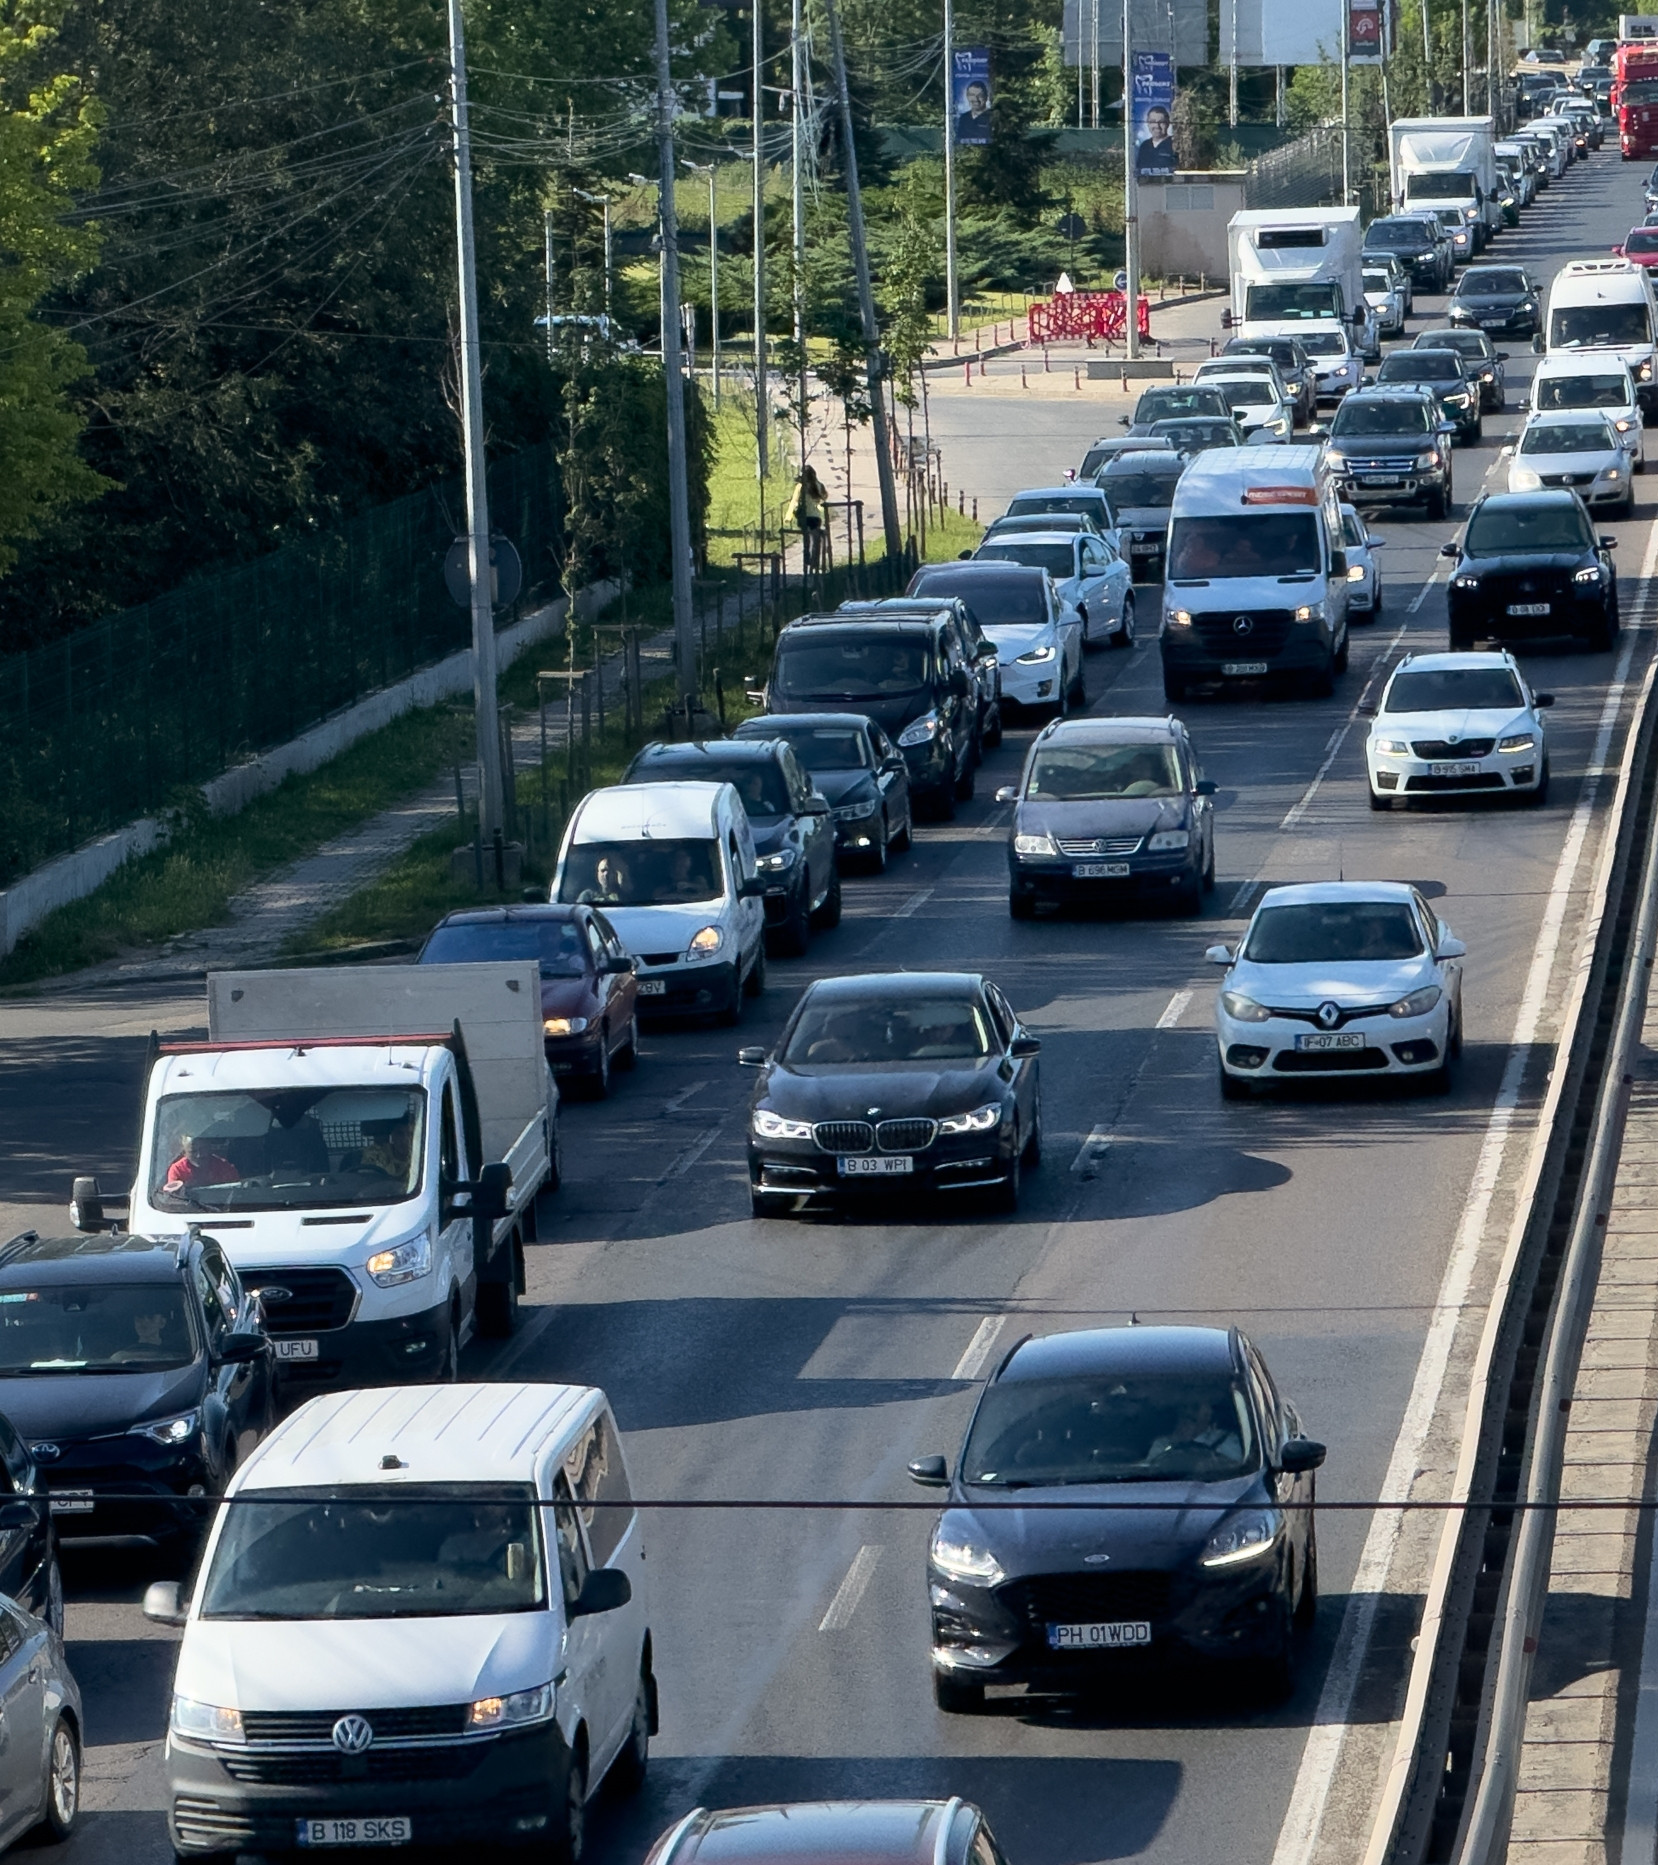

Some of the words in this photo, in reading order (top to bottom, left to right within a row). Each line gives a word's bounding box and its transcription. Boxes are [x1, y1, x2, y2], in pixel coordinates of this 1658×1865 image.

[1336, 1035, 1360, 1047] ABC
[848, 1159, 857, 1172] B
[861, 1159, 878, 1172] 03
[884, 1158, 907, 1171] WPI
[280, 1342, 312, 1356] UFU
[1057, 1626, 1083, 1644] PH
[312, 1822, 326, 1841] B
[332, 1821, 357, 1840] 118
[363, 1820, 405, 1839] SKS
